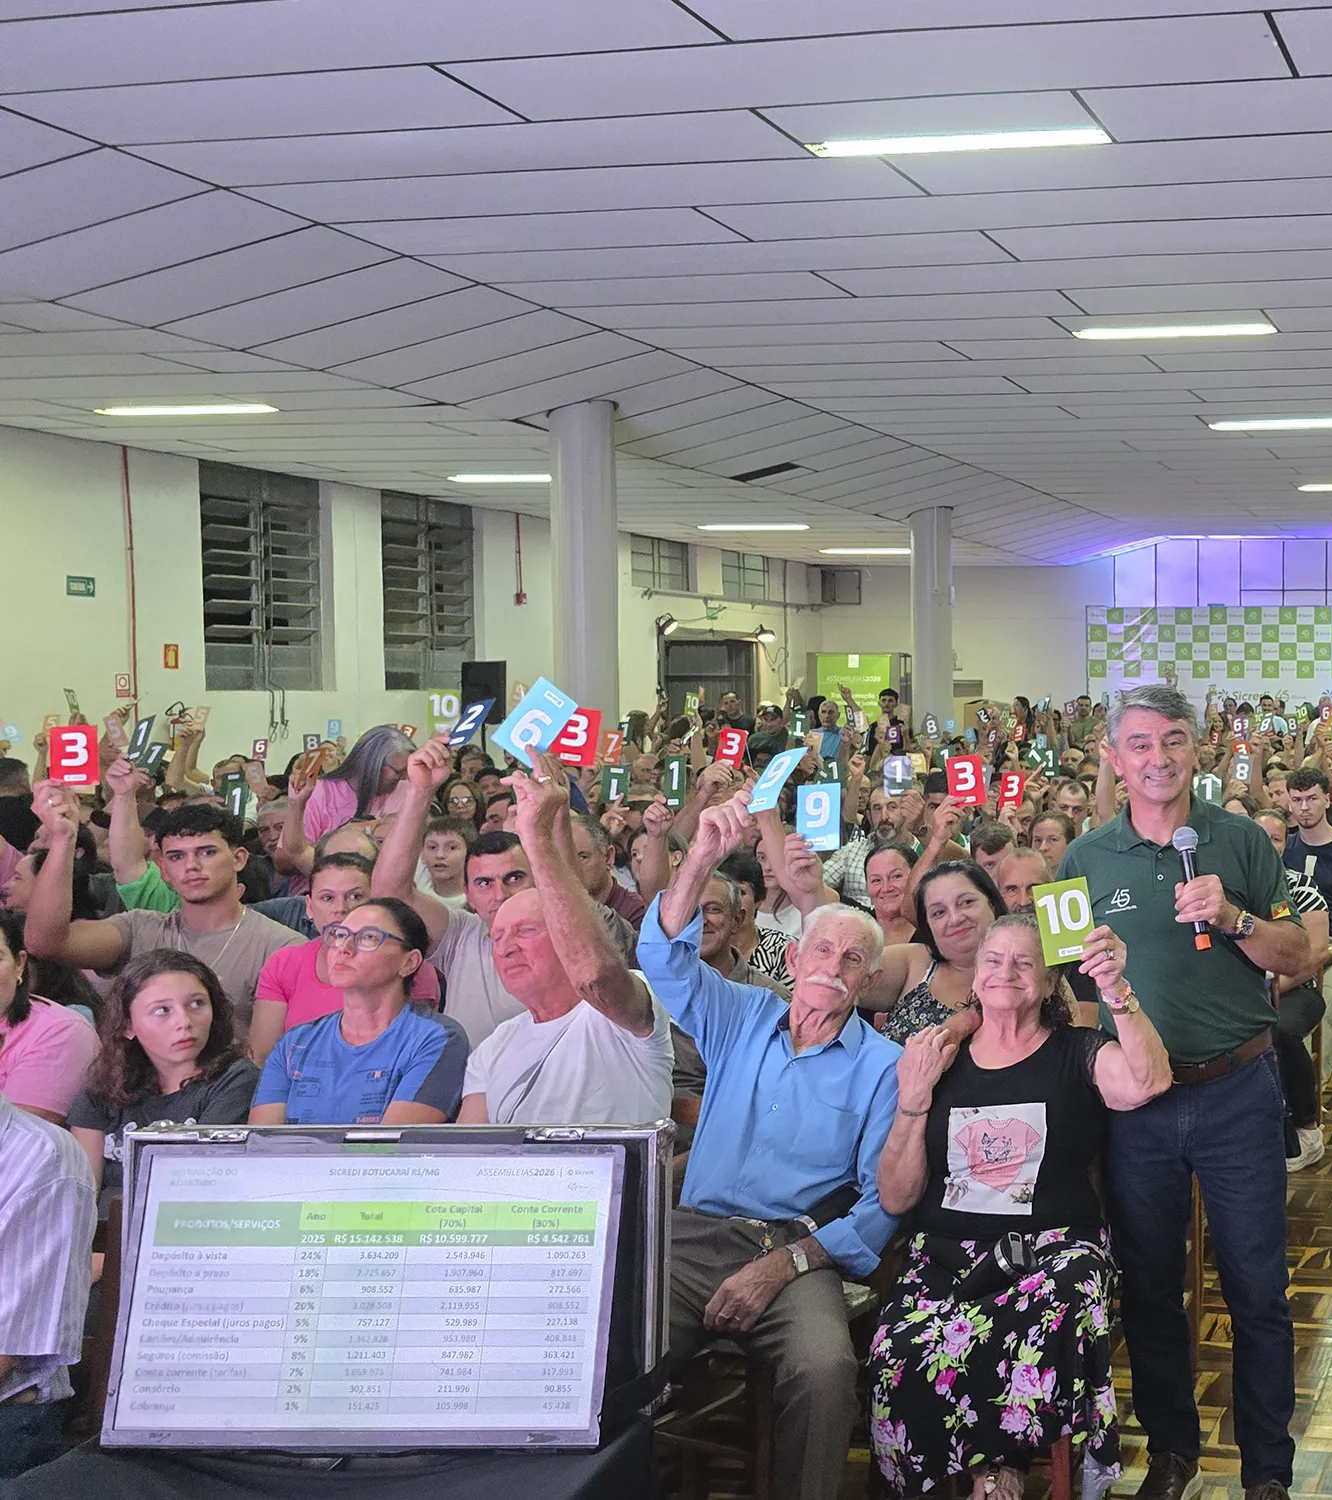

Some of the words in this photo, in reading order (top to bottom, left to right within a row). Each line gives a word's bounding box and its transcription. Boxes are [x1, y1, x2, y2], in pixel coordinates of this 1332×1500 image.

[429, 694, 459, 717] 10
[686, 695, 699, 709] 10
[846, 707, 854, 718] 8
[1066, 704, 1074, 714] 6
[1297, 707, 1308, 719] 10
[1322, 707, 1329, 718] 6
[456, 704, 485, 732] 2
[926, 719, 937, 734] 8
[1233, 718, 1242, 732] 6
[1260, 717, 1271, 732] 8
[1288, 718, 1297, 730] 8
[137, 721, 148, 746] 1
[560, 713, 589, 747] 3
[621, 723, 629, 738] 1
[888, 728, 897, 738] 6
[989, 729, 996, 742] 6
[1014, 725, 1023, 737] 3
[306, 736, 318, 749] 8
[1212, 732, 1219, 744] 3
[61, 732, 88, 766] 3
[255, 740, 265, 753] 6
[607, 734, 619, 754] 7
[722, 733, 741, 755] 3
[148, 745, 161, 763] 1
[305, 751, 321, 774] 7
[669, 760, 679, 790] 1
[759, 755, 791, 789] 9
[828, 761, 838, 780] 1
[890, 760, 903, 783] 1
[953, 761, 976, 791] 3
[1236, 763, 1249, 781] 8
[1004, 775, 1020, 798] 3
[1201, 778, 1213, 800] 1
[232, 787, 241, 816] 1
[805, 791, 831, 828] 9
[1111, 888, 1130, 908] 45
[1037, 889, 1090, 935] 10
[425, 1205, 447, 1214] Cota
[449, 1205, 483, 1215] Capital
[511, 1206, 539, 1214] Conta
[541, 1206, 583, 1214] Corrente
[306, 1212, 326, 1221] Ano
[360, 1212, 383, 1221] Total
[439, 1218, 466, 1229] (70%)
[532, 1218, 560, 1229] (30%)
[301, 1234, 326, 1244] 2025
[334, 1234, 347, 1244] R$
[350, 1234, 403, 1244] 15.142.538
[420, 1234, 432, 1245] R$
[434, 1234, 488, 1244] 10.599.777
[528, 1234, 540, 1245] R$
[542, 1234, 590, 1244] 4.542.761
[151, 1250, 195, 1262] Depósito
[206, 1252, 228, 1260] vista
[301, 1251, 322, 1260] 24%
[360, 1251, 399, 1260] 3.634.209
[446, 1251, 485, 1260] 2.543.946
[547, 1251, 586, 1260] 1.090.263
[299, 1269, 320, 1278] 18%
[299, 1285, 314, 1294] 6%
[449, 1286, 482, 1294] 635.987
[294, 1302, 315, 1311] 20%
[440, 1301, 480, 1310] 2.119.955
[142, 1318, 178, 1329] Cheque
[181, 1318, 220, 1329] Especial
[222, 1318, 251, 1329] (juros
[252, 1318, 285, 1329] pagos)
[295, 1318, 310, 1327] 5%
[357, 1319, 390, 1327] 757.127
[293, 1335, 308, 1344] 9%
[137, 1351, 175, 1362] Seguros
[178, 1350, 229, 1361] (comissão)
[291, 1351, 306, 1360] 8%
[166, 1369, 207, 1377] corrente
[289, 1368, 303, 1377] 7%
[133, 1384, 180, 1394] Consórcio
[287, 1385, 301, 1394] 2%
[349, 1385, 382, 1394] 302.851
[437, 1385, 470, 1393] 211.996
[544, 1385, 572, 1393] 90.855
[285, 1402, 299, 1411] 1%
